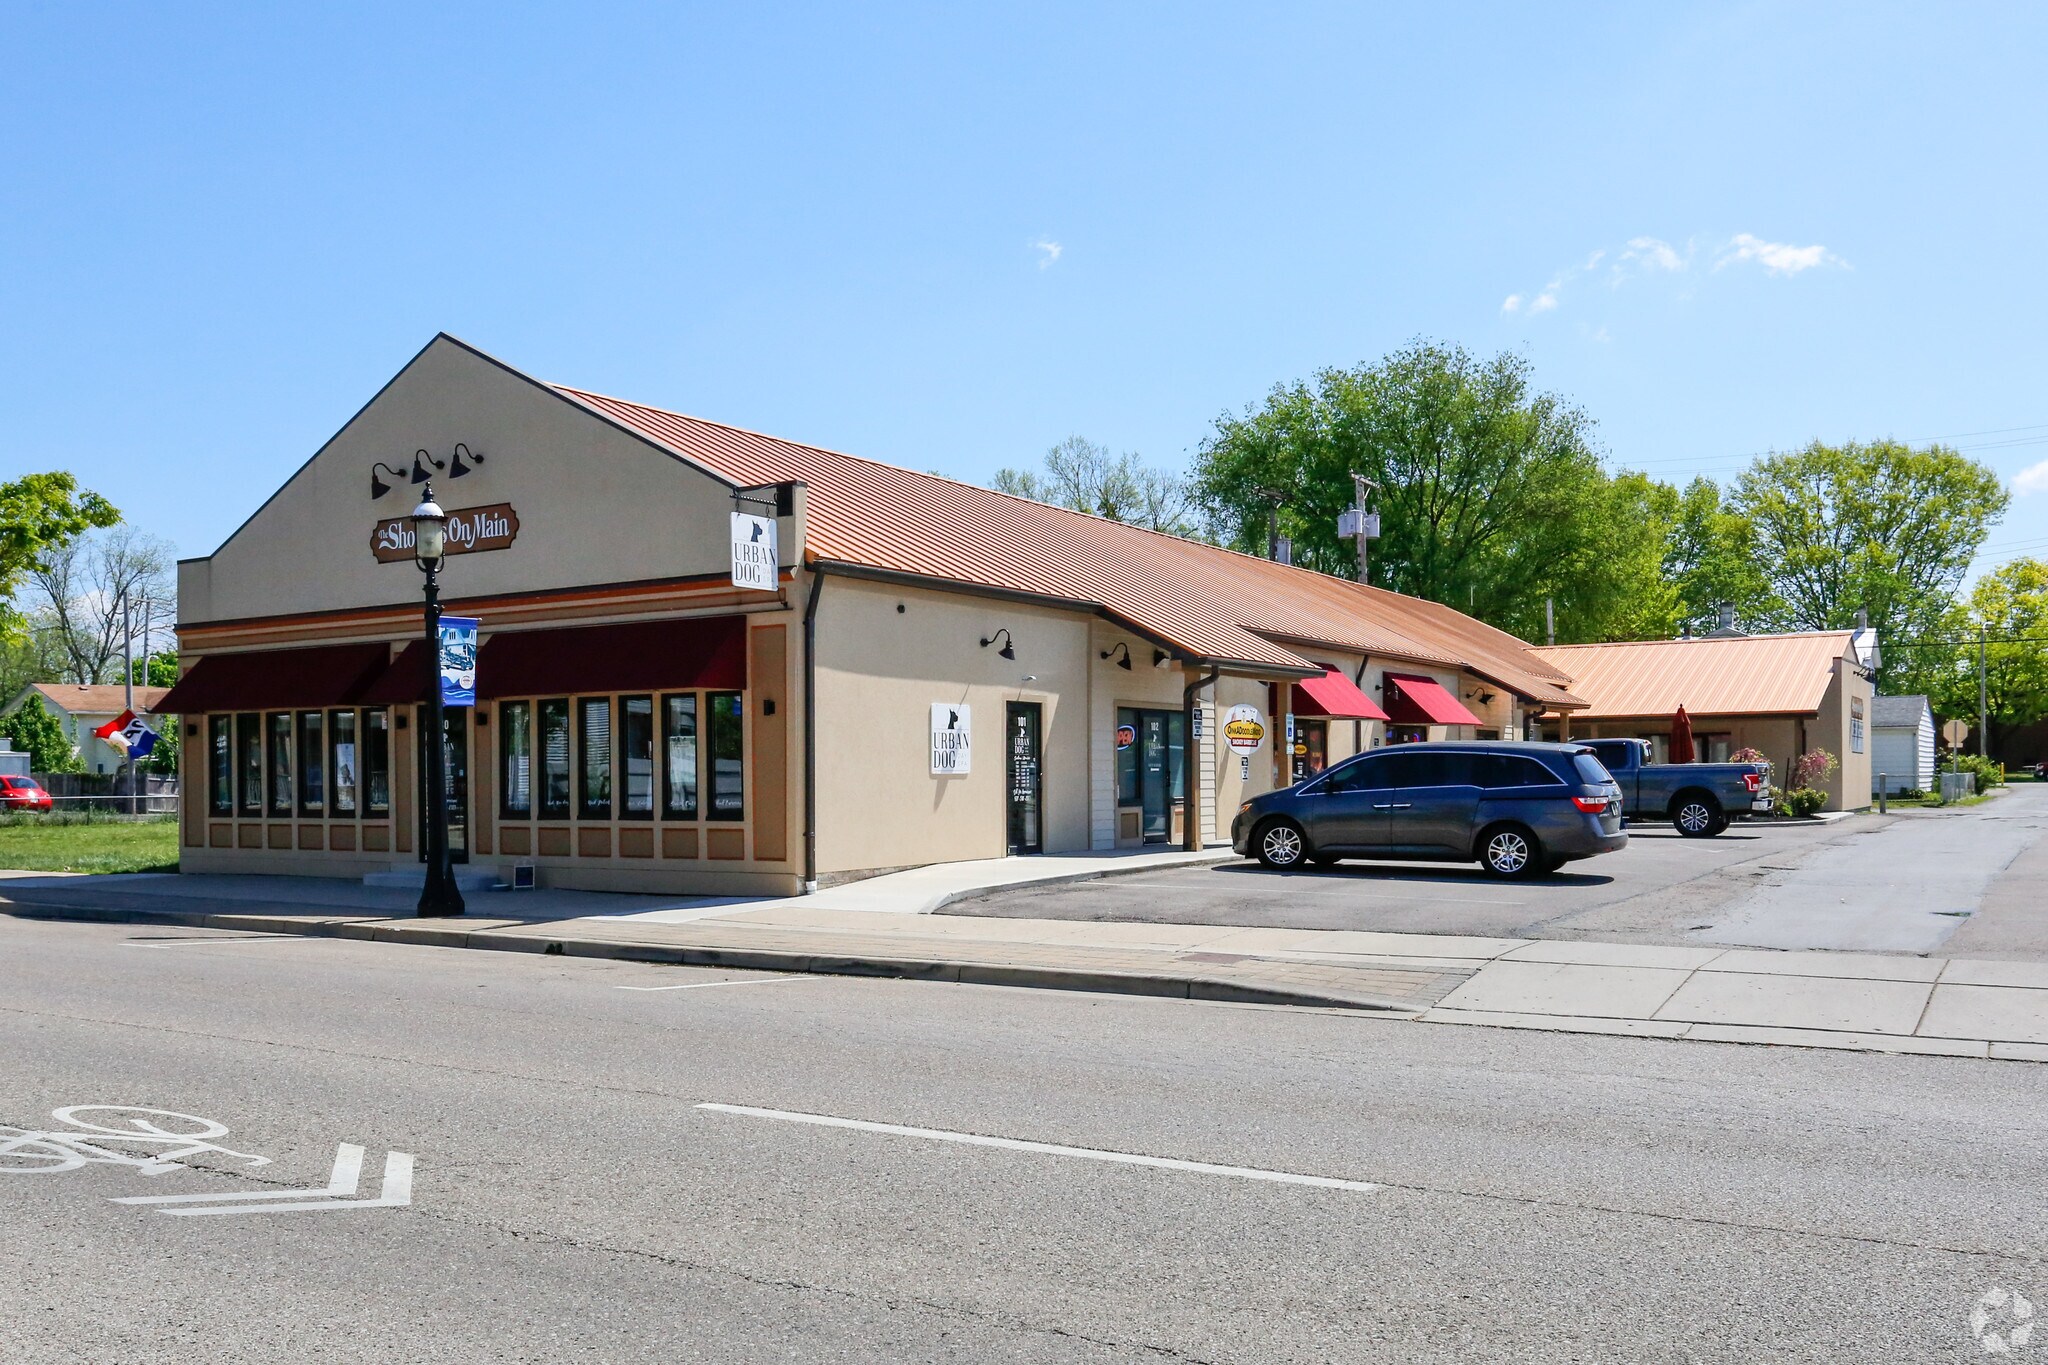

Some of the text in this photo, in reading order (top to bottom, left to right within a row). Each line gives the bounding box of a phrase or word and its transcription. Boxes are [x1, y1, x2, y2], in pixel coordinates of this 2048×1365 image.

[378, 512, 510, 550] The Shos On Main
[734, 542, 776, 566] URBAN
[735, 562, 760, 583] DOG
[933, 732, 969, 750] URBAN
[1117, 730, 1133, 745] PEN
[933, 750, 956, 768] DOG
